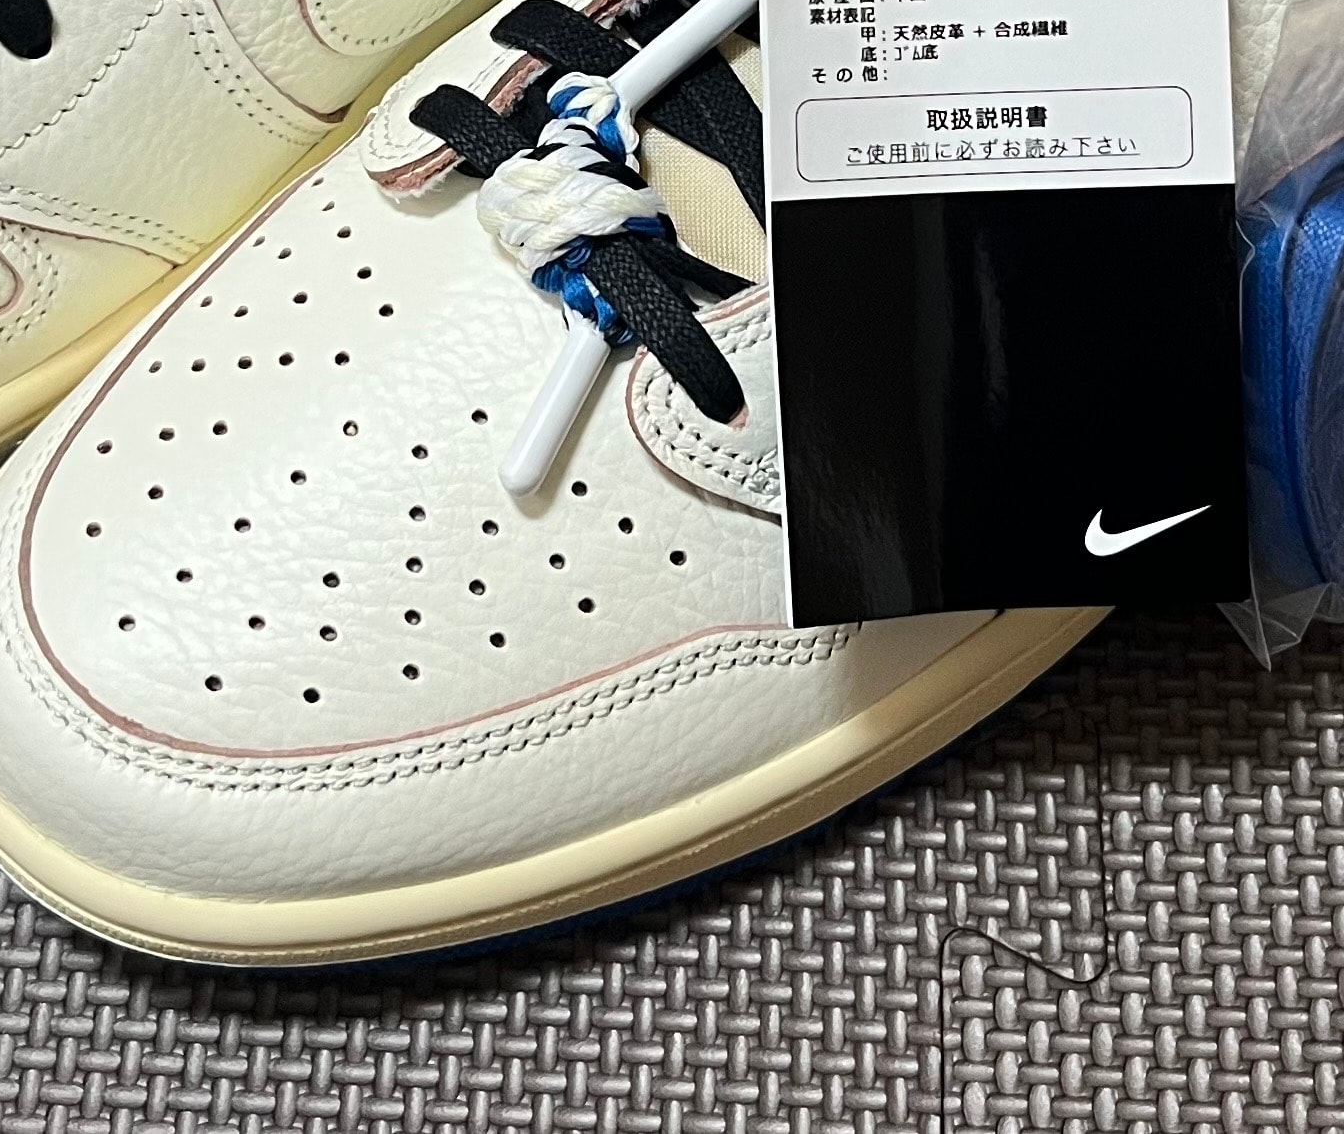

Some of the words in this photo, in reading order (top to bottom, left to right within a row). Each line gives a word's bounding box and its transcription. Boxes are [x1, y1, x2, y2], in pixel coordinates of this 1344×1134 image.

[810, 6, 876, 25] 素材表記
[926, 105, 1048, 131] 取扱説明書
[846, 137, 1137, 165] ご使用前に必ずお読み下さい
